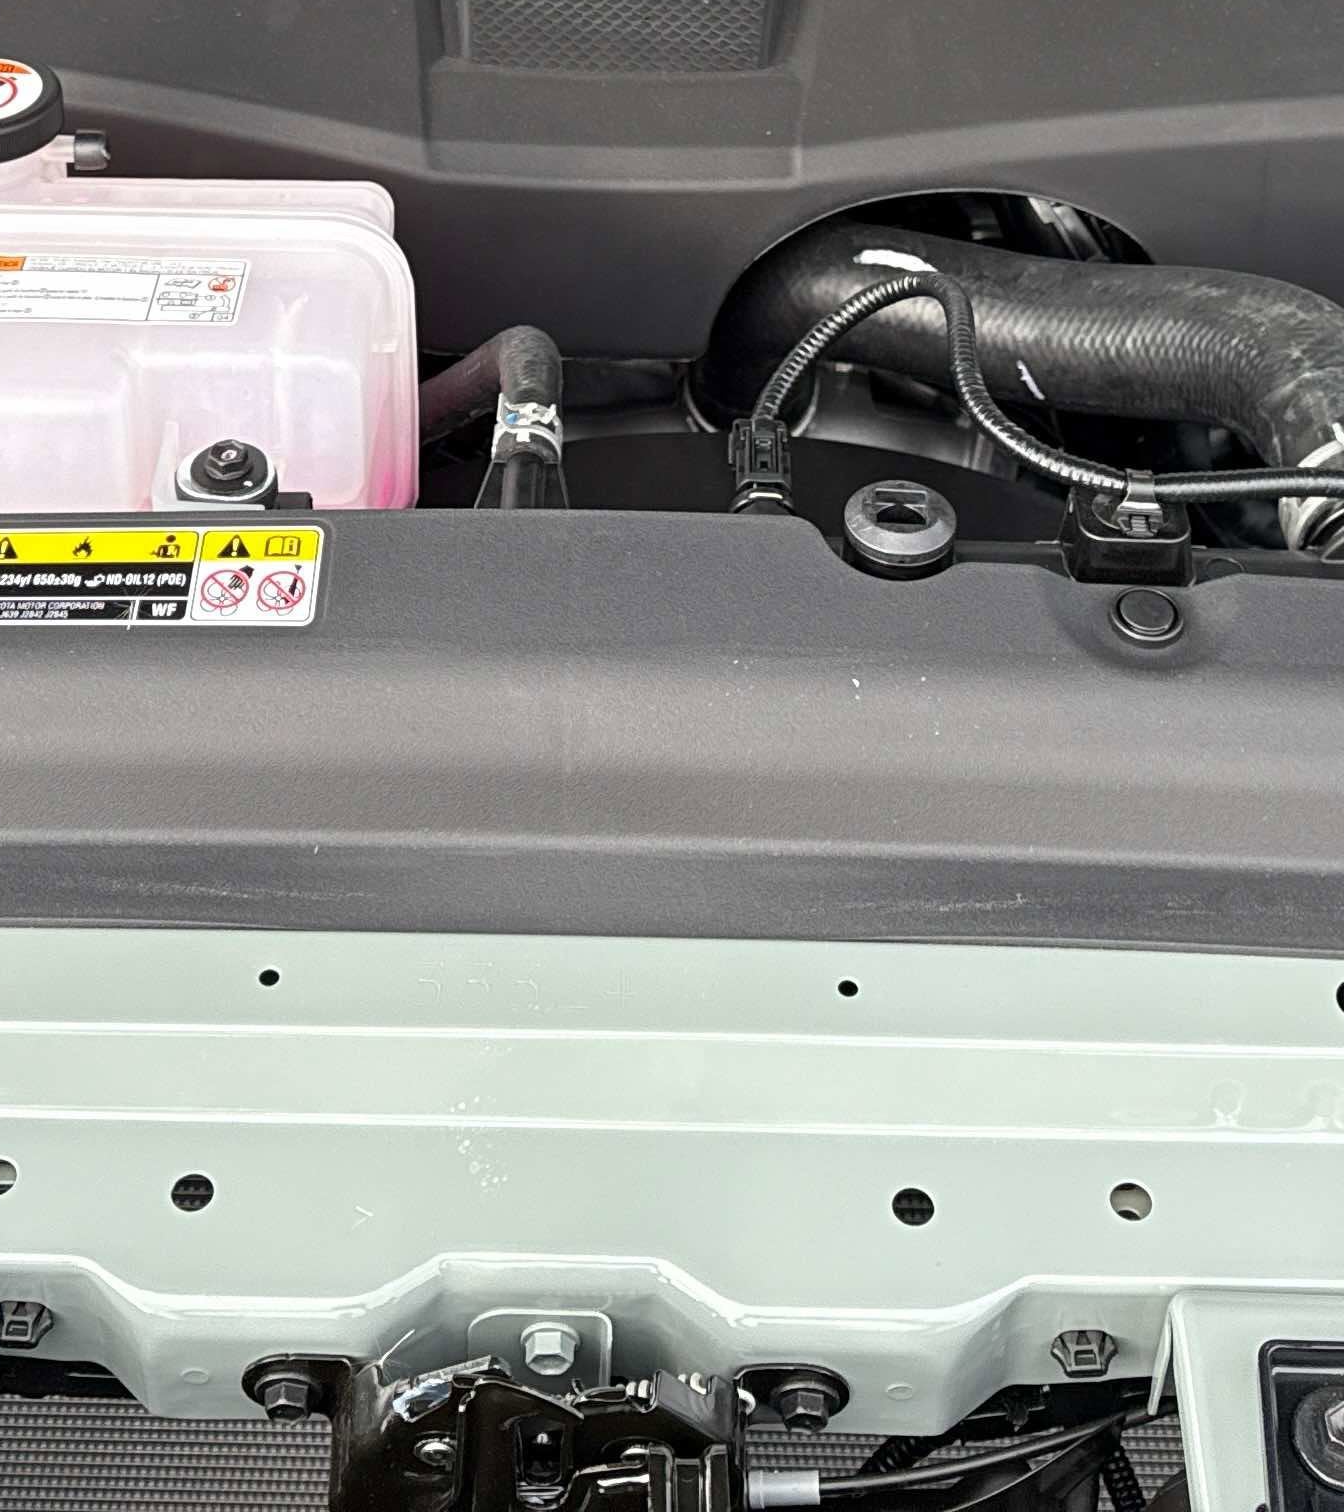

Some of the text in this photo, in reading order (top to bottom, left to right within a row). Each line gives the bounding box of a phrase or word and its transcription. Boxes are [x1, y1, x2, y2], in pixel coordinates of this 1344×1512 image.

[16, 601, 47, 610] MOTOR
[47, 601, 106, 610] CORPORATION
[151, 602, 178, 617] WF
